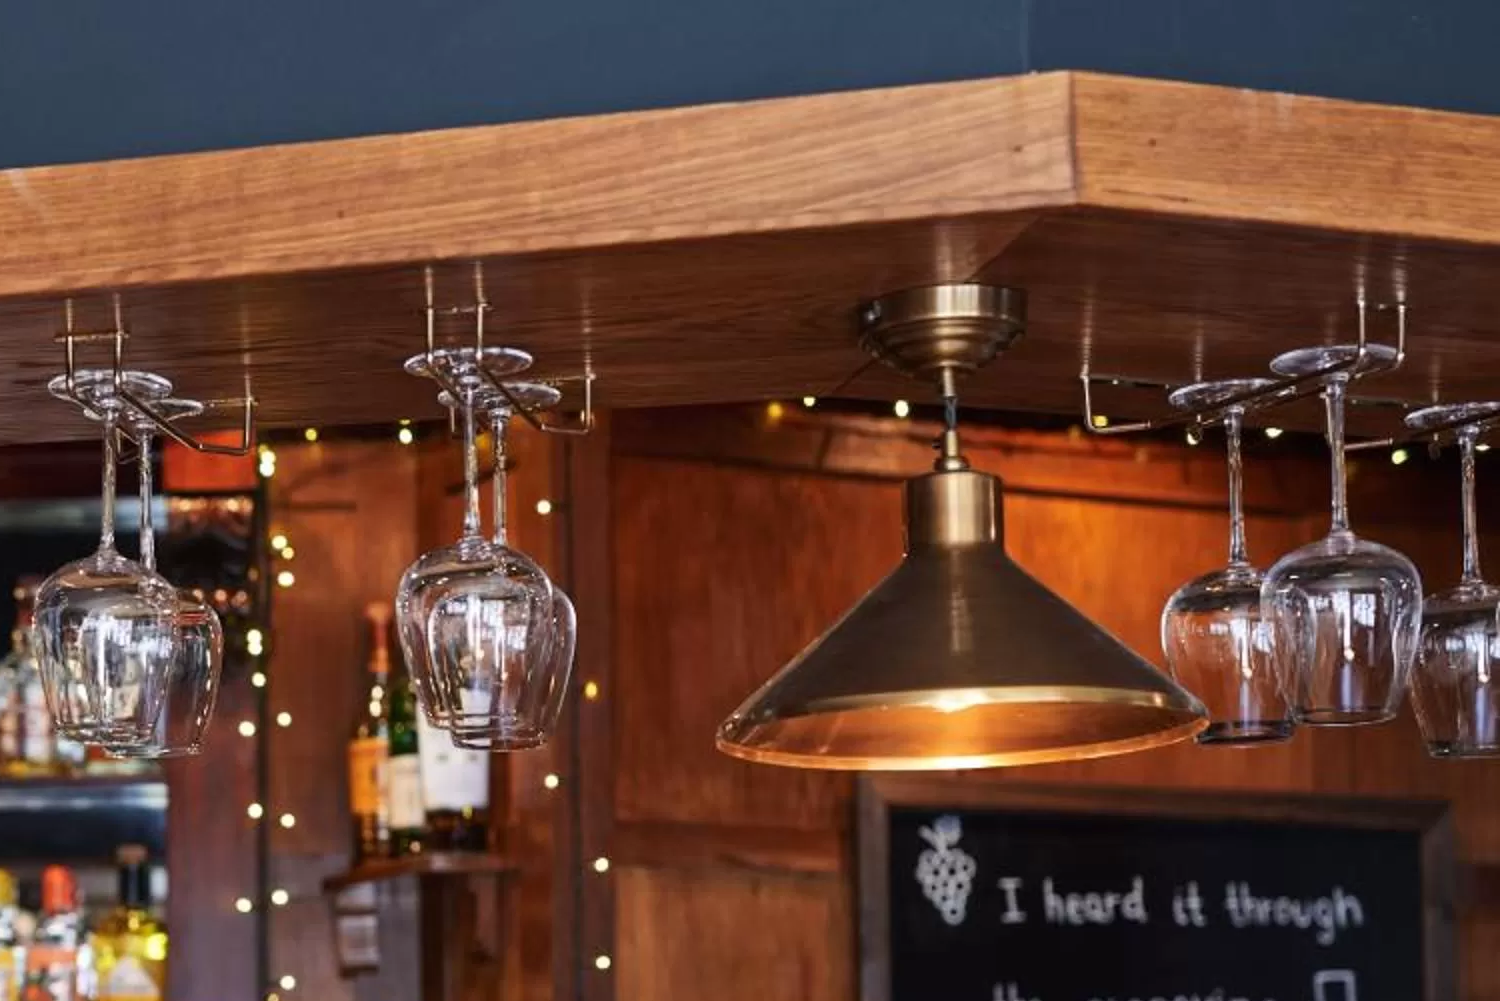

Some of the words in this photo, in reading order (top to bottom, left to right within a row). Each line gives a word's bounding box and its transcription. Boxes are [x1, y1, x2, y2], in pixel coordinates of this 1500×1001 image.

[998, 876, 1027, 924] I
[1043, 874, 1148, 925] heard
[1172, 880, 1205, 927] it
[1224, 880, 1364, 945] through
